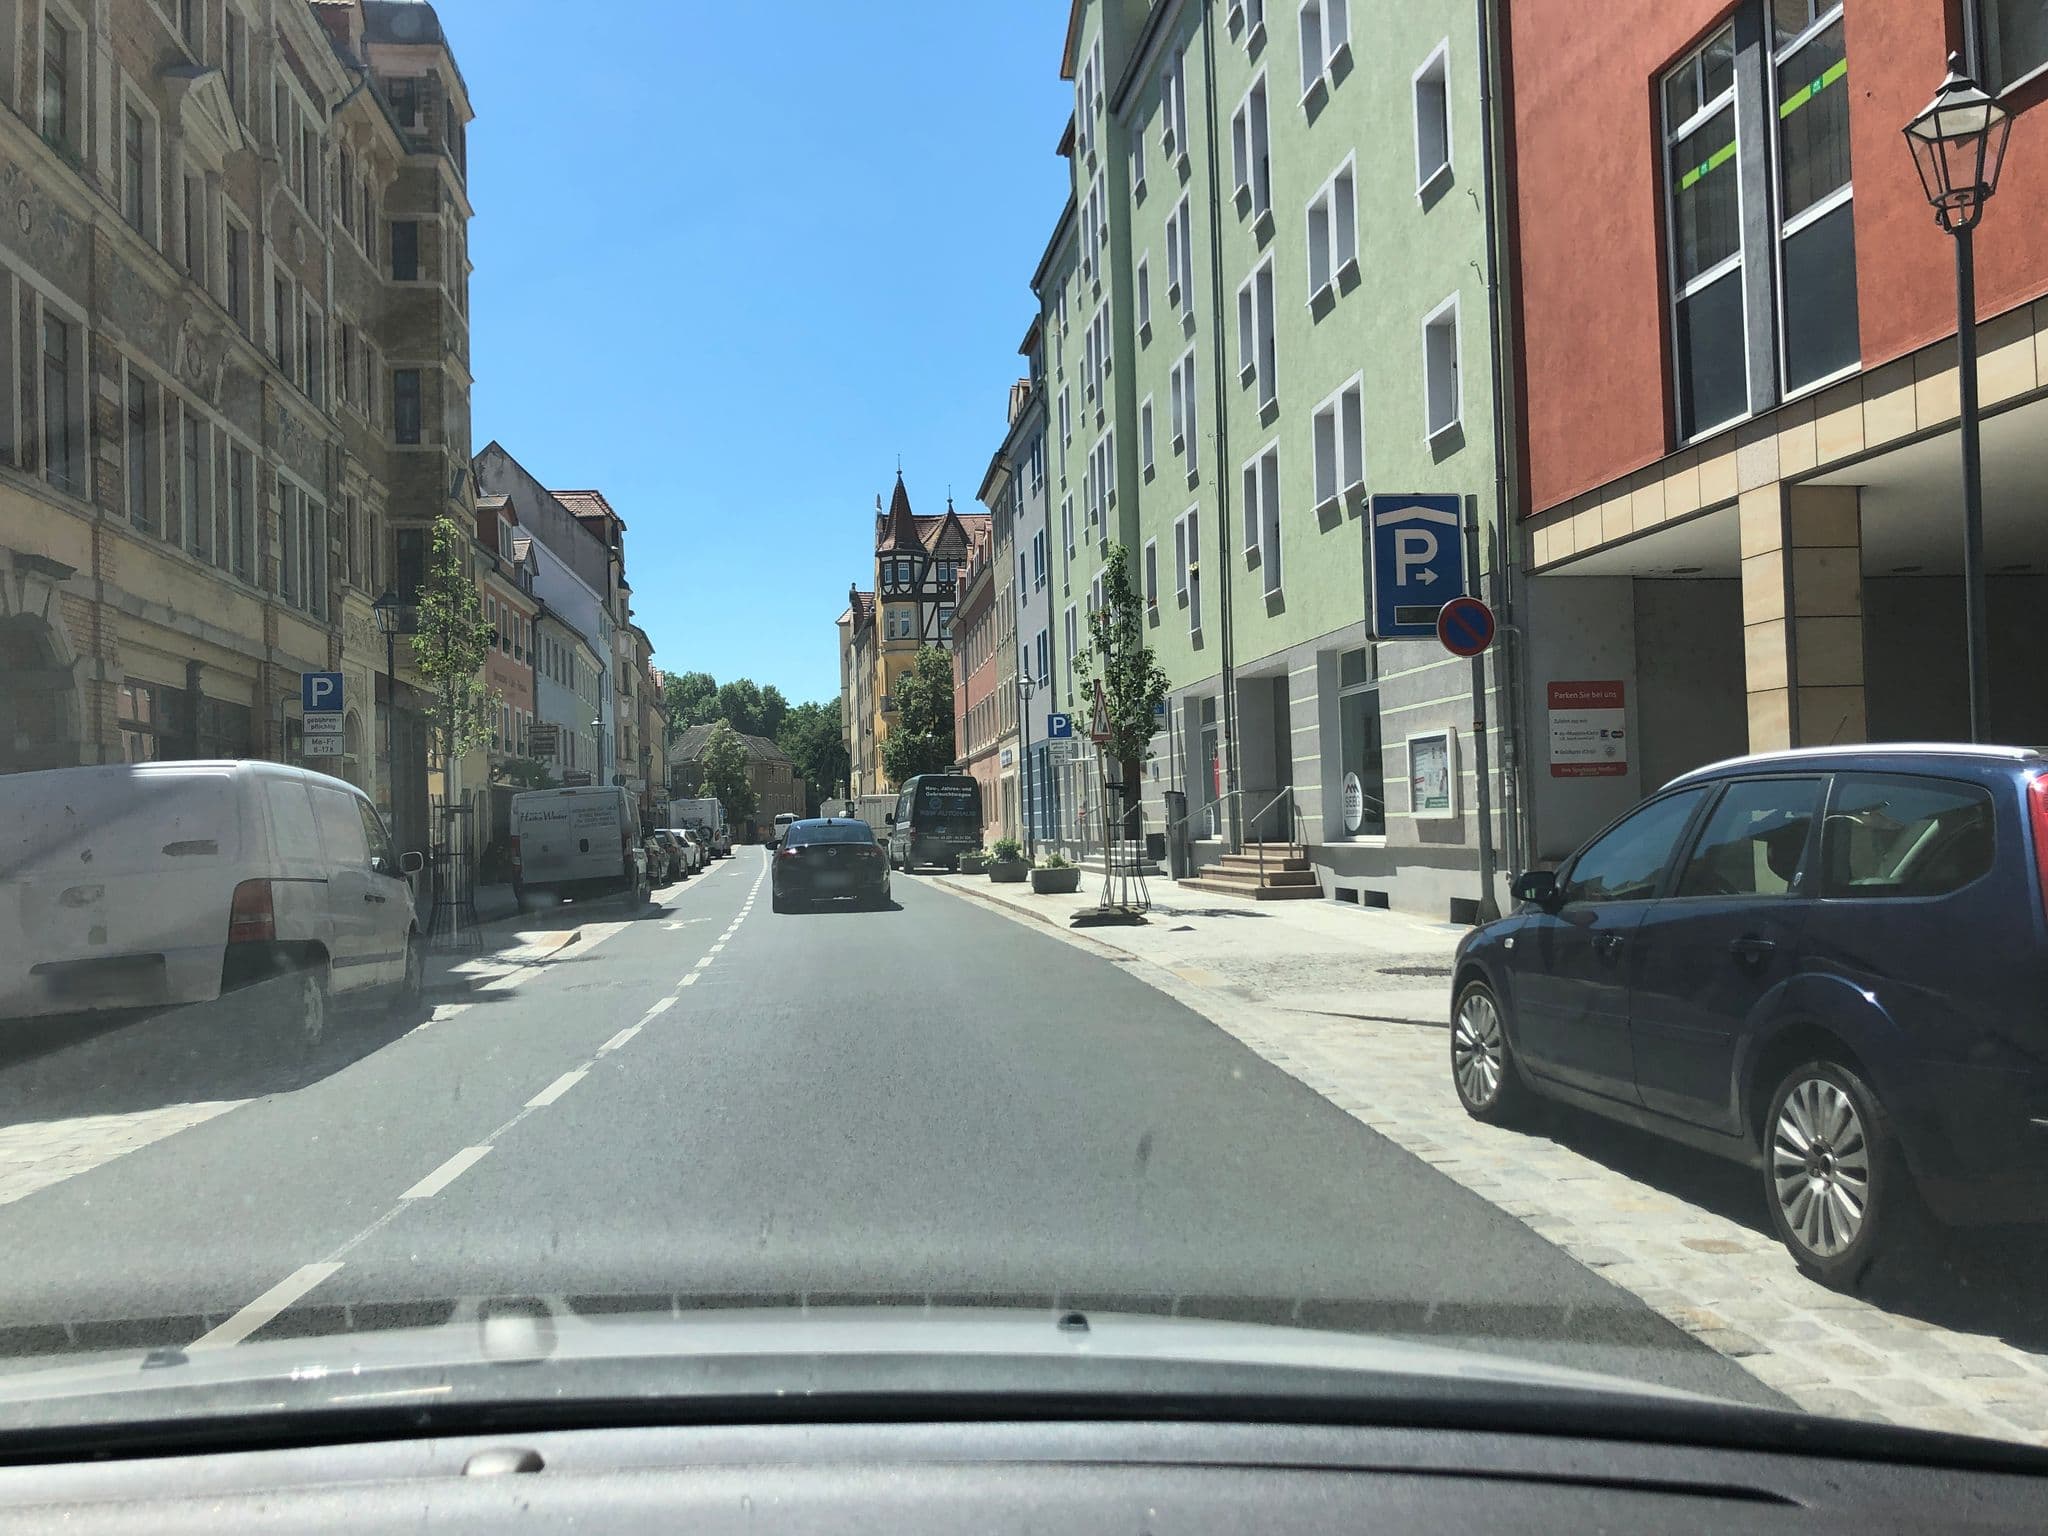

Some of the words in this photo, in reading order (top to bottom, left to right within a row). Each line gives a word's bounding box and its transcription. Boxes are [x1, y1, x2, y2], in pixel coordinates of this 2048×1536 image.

[1394, 528, 1438, 586] P
[312, 677, 333, 706] P
[1554, 691, 1578, 699] Parken
[1604, 690, 1617, 698] uns
[1053, 716, 1066, 735] P
